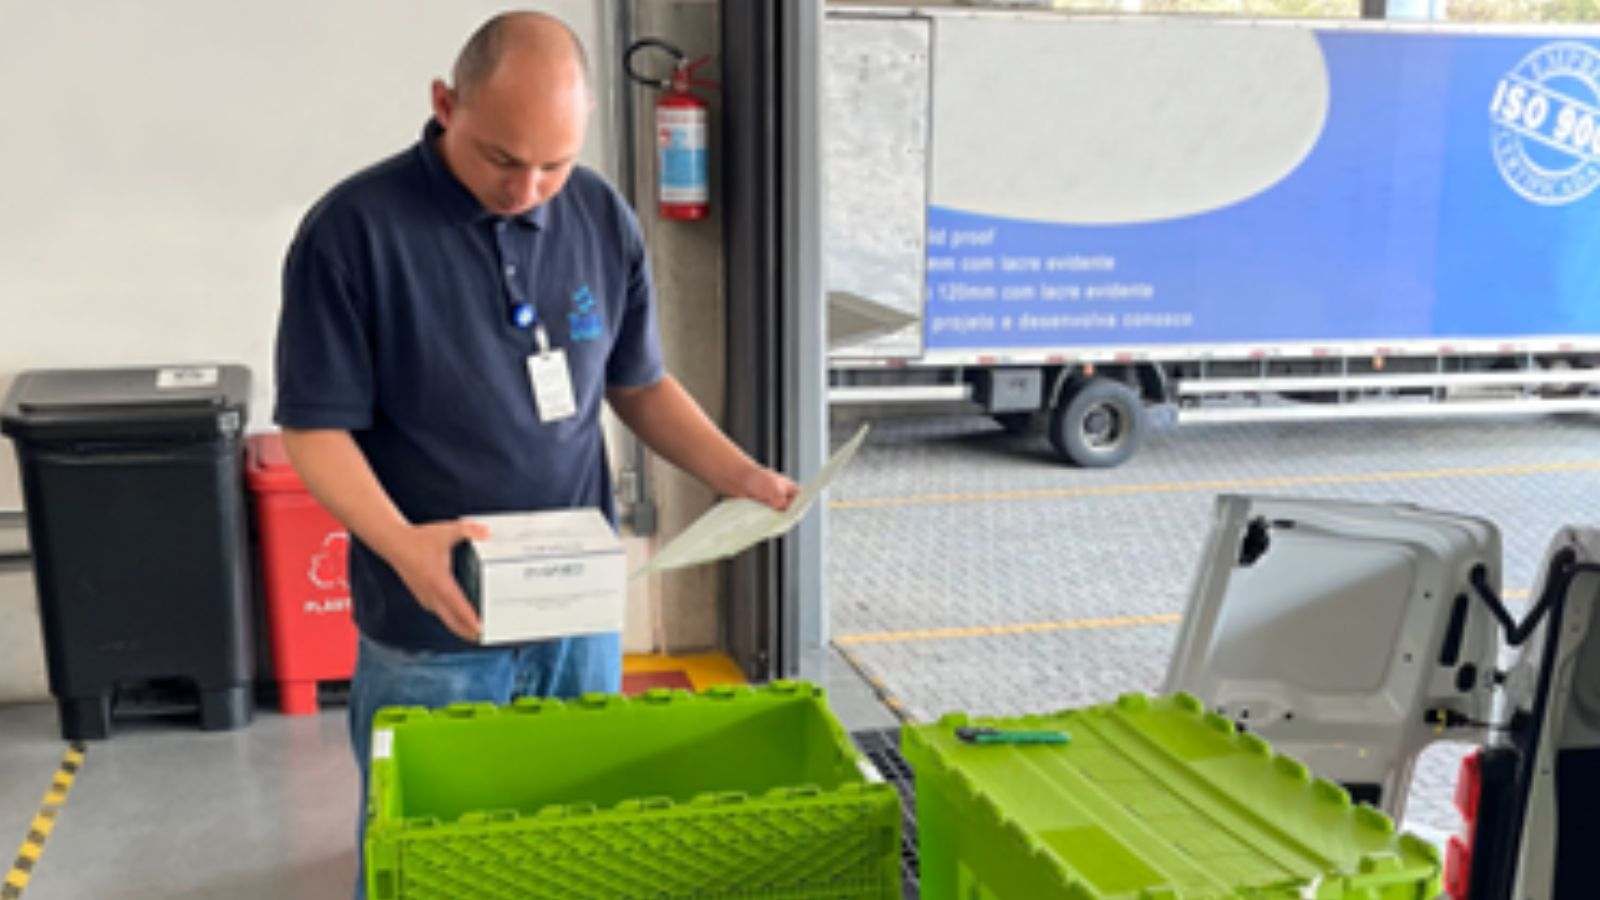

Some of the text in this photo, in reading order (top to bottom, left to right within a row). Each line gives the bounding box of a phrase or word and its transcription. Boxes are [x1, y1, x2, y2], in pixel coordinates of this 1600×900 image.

[1491, 80, 1548, 129] ISO
[952, 228, 996, 249] proof
[962, 257, 994, 271] com
[1047, 253, 1115, 271] evidente
[1002, 285, 1034, 300] com
[1086, 282, 1154, 299] evidente
[932, 314, 994, 332] projeto
[1002, 317, 1011, 329] e
[1122, 313, 1193, 328] conosco
